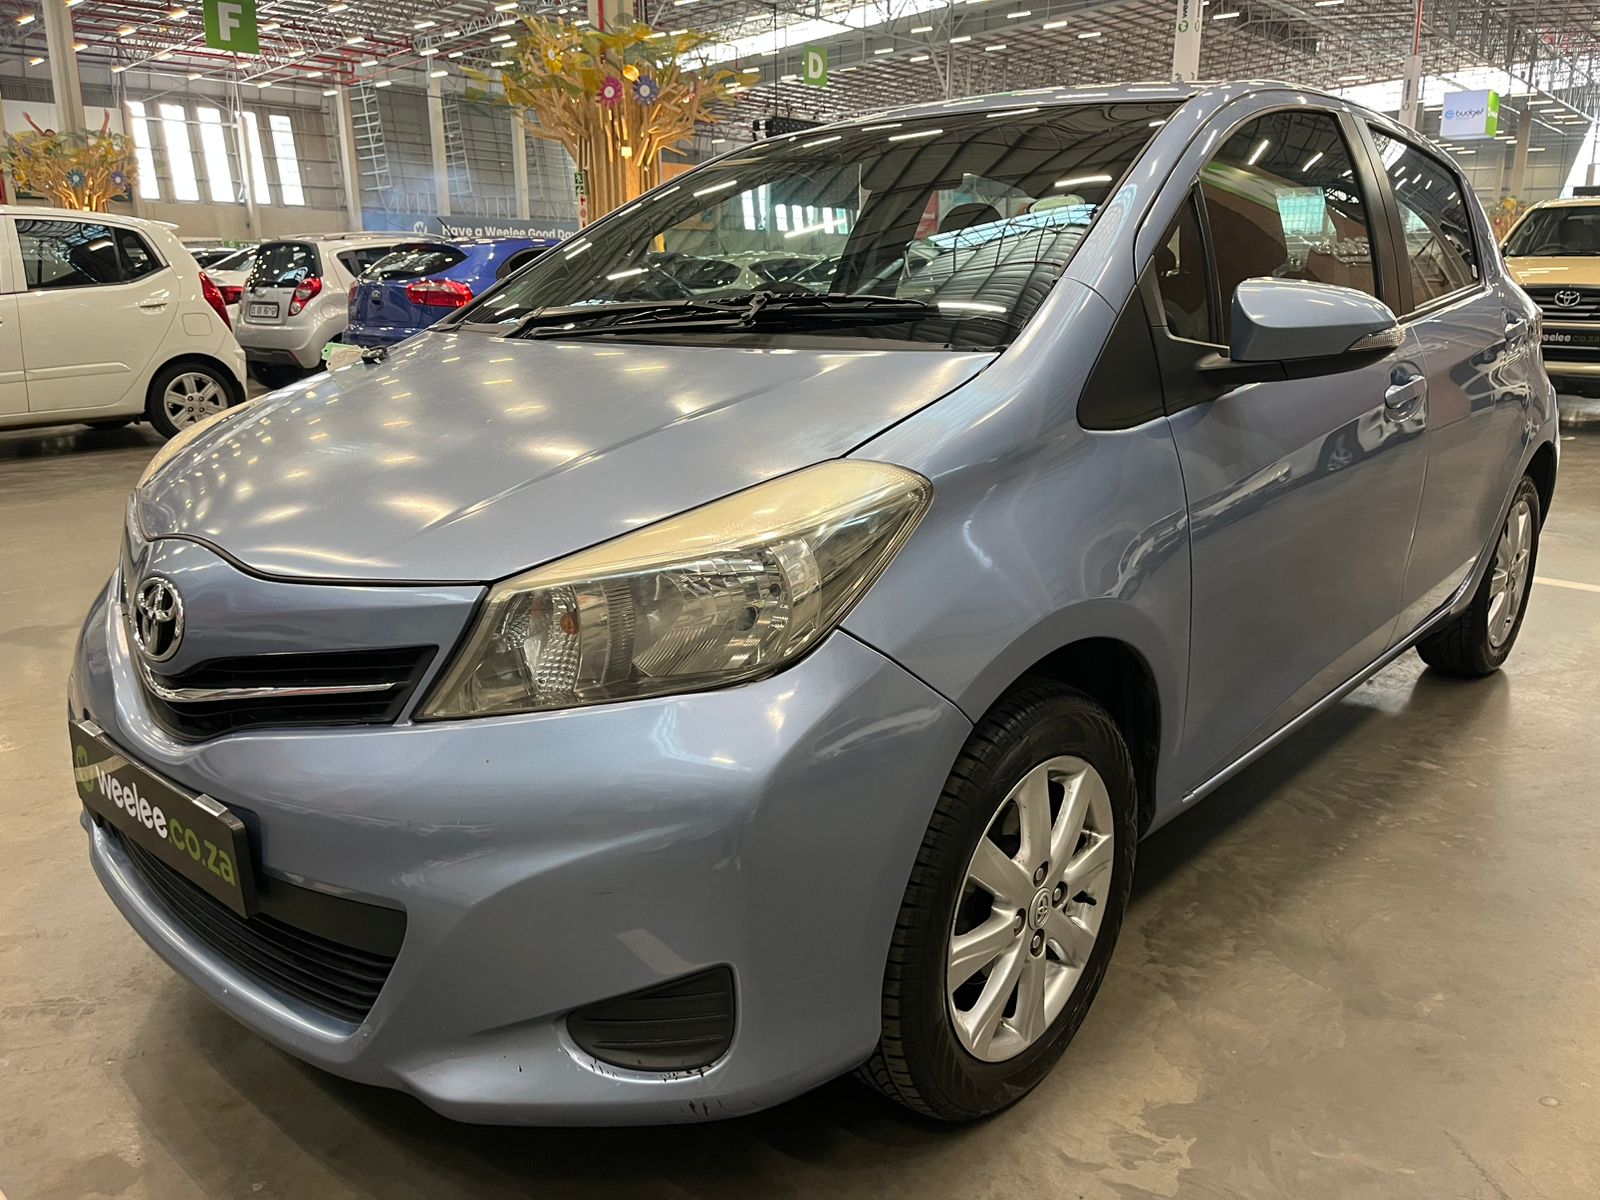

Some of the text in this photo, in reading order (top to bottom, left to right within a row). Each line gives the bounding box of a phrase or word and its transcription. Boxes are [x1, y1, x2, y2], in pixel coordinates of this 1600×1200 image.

[217, 2, 242, 41] F
[808, 51, 824, 79] D
[441, 224, 474, 237] Have
[474, 227, 483, 237] a
[486, 226, 525, 238] Weelee
[527, 227, 556, 238] Good
[95, 764, 236, 887] weelee.co.za
